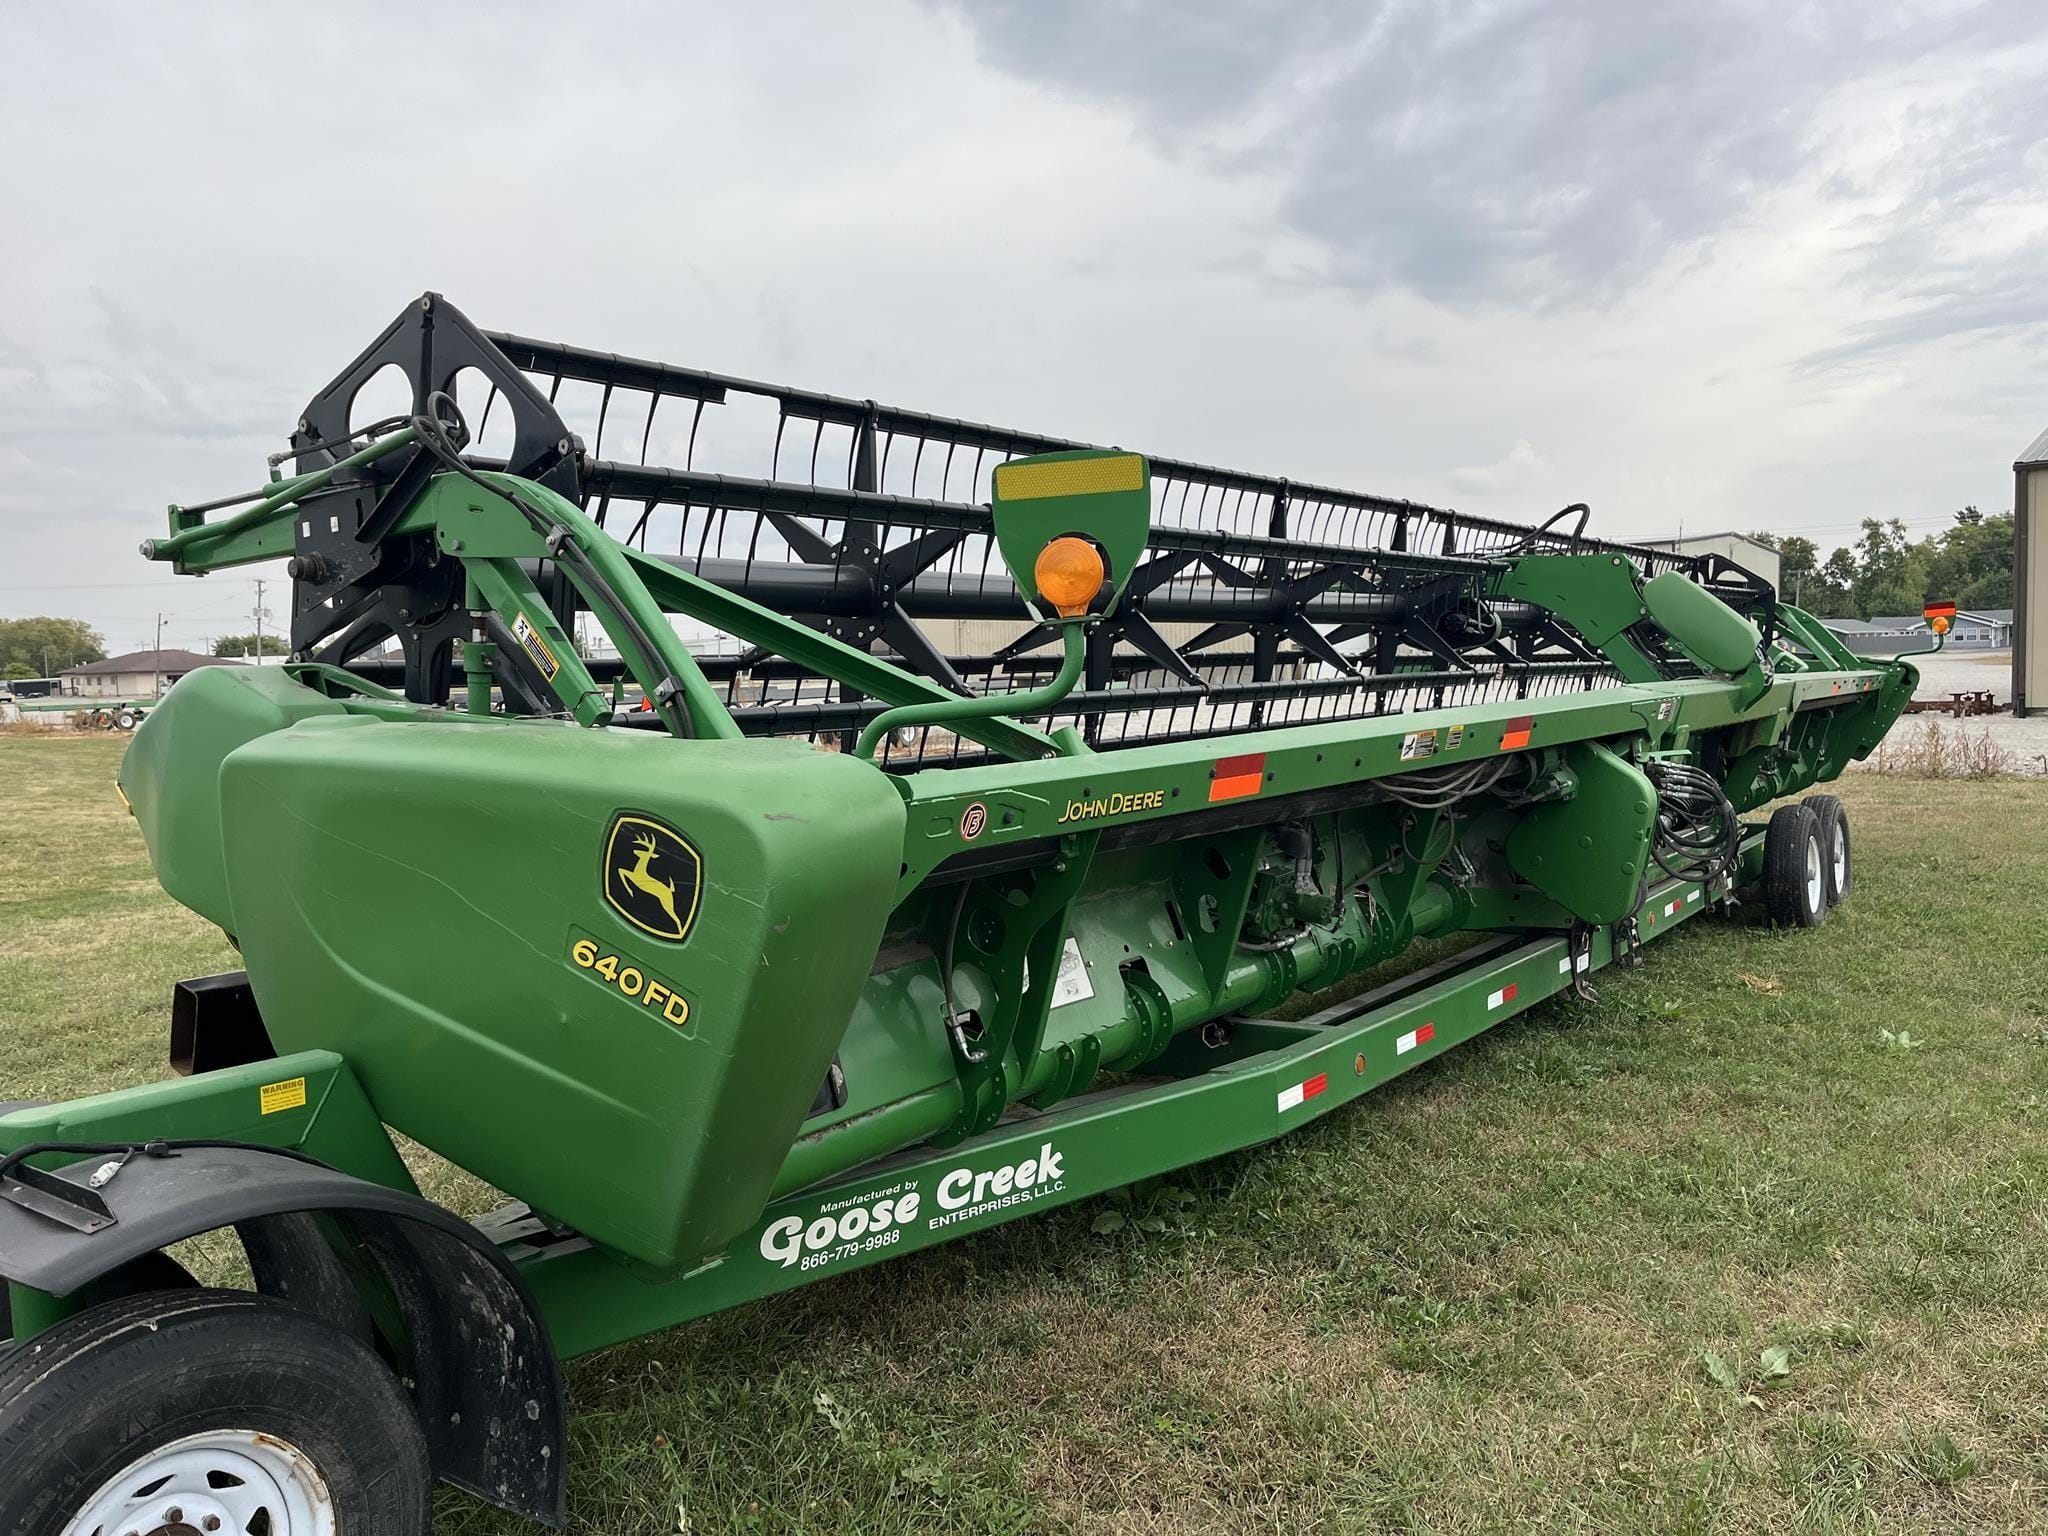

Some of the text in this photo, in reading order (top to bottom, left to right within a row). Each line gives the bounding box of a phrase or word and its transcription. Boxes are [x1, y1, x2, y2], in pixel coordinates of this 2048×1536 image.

[1057, 789, 1165, 823] JOHN DEERE
[262, 1079, 304, 1095] WARNING
[760, 1142, 1065, 1269] Goose Creek
[820, 1180, 919, 1214] Manufactured by
[928, 1180, 1067, 1230] ENTERPRISES, L.L.C.
[800, 1229, 900, 1271] 866-779-9988
